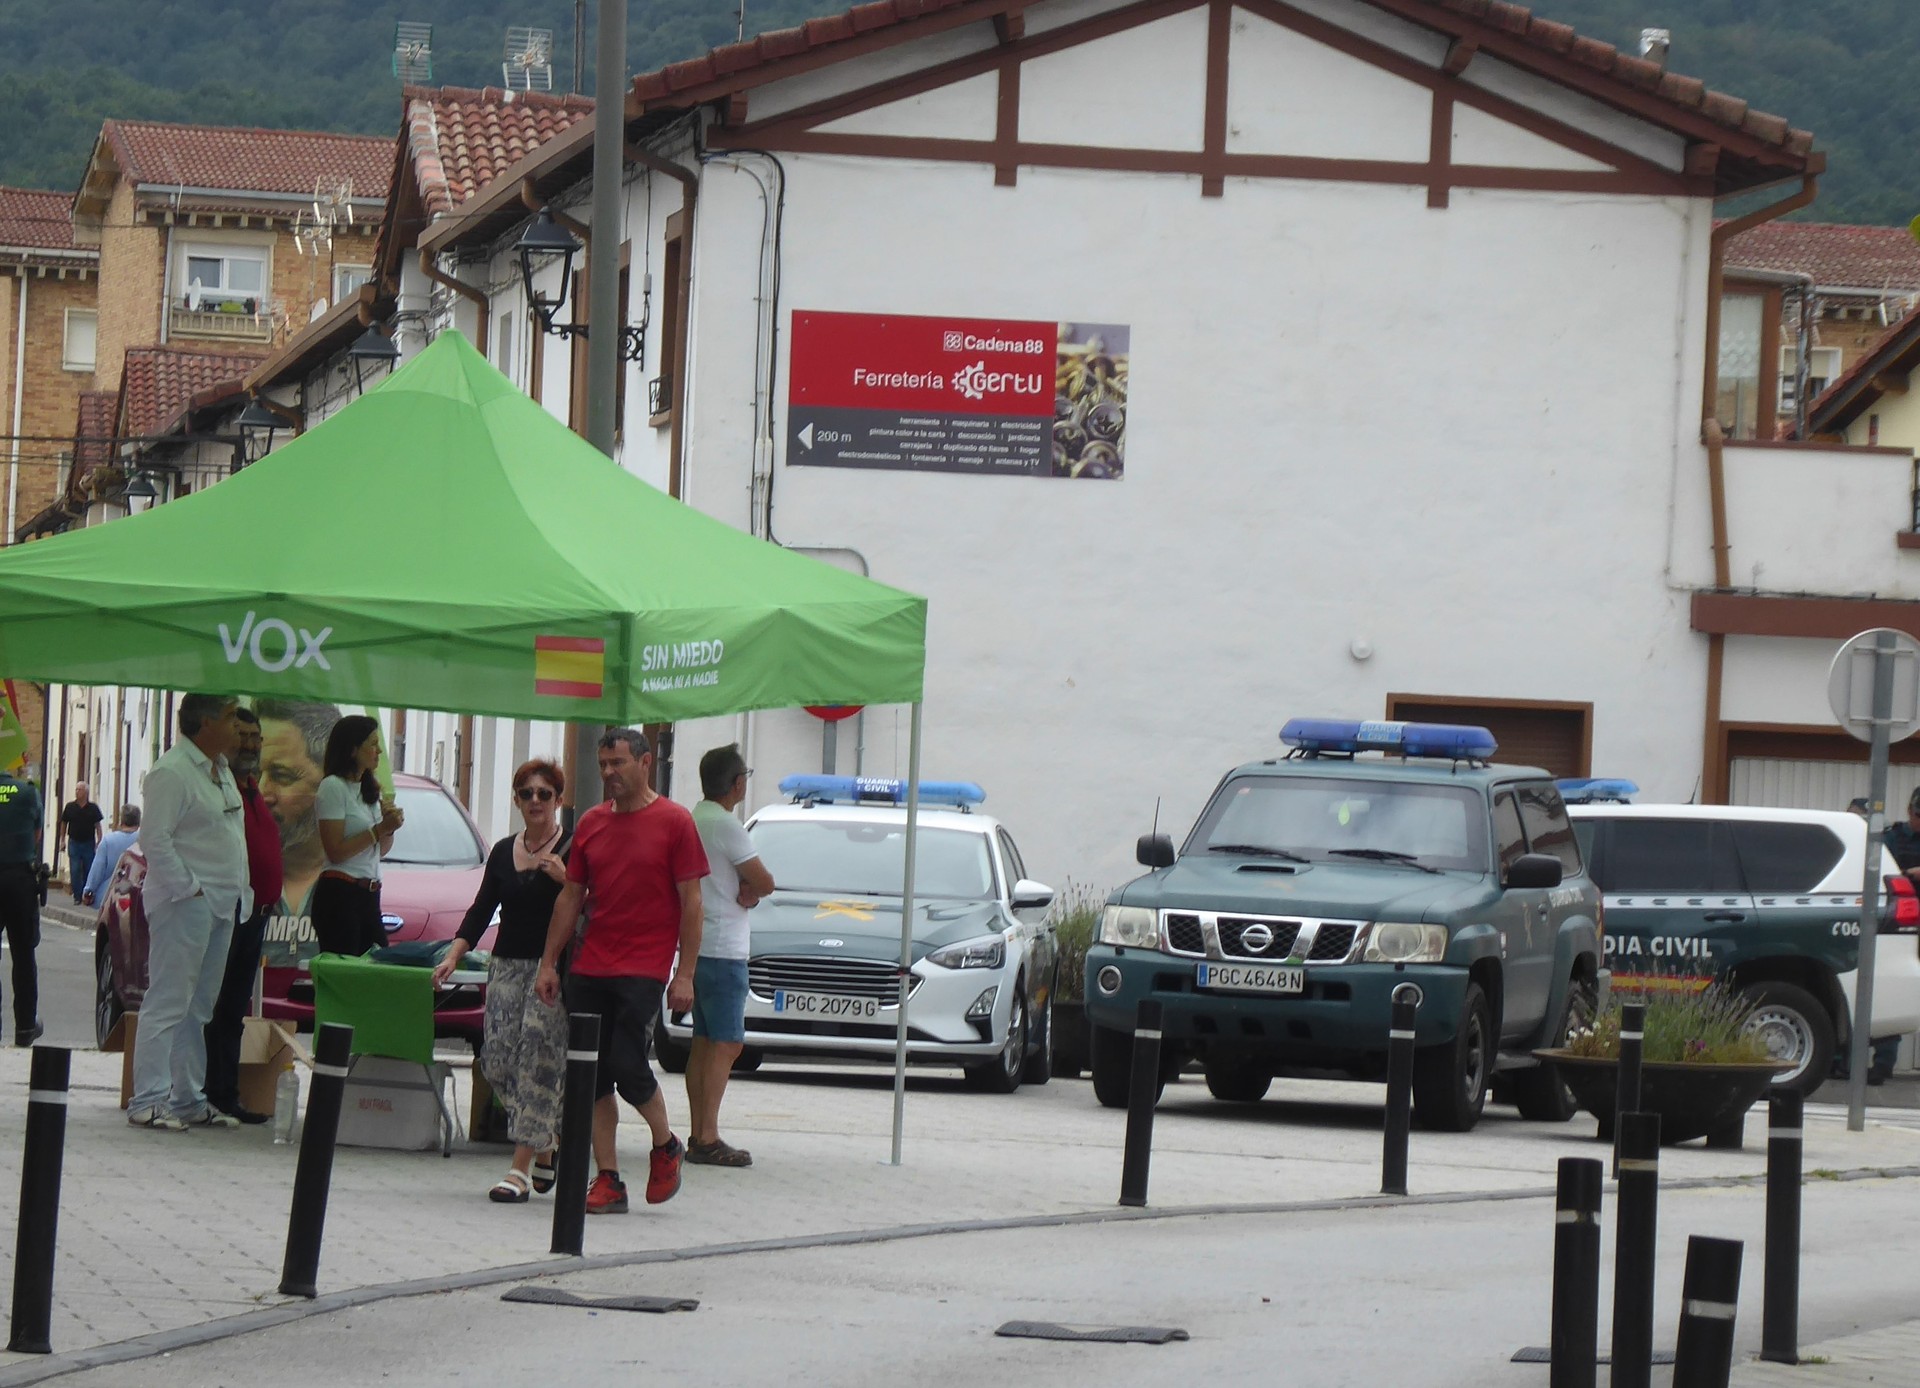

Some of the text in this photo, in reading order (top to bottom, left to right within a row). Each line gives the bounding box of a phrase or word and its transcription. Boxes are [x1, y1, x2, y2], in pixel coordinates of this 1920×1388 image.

[853, 368, 944, 390] Ferretería
[816, 429, 852, 443] 200 m
[217, 610, 333, 672] VOX
[641, 638, 724, 671] SIN MIEDO
[641, 677, 650, 694] A
[684, 673, 692, 689] A
[692, 670, 720, 688] NADIE
[856, 777, 900, 787] GUARDIA
[863, 784, 891, 793] CIVIL
[1603, 934, 1713, 958] DIA CIVIL
